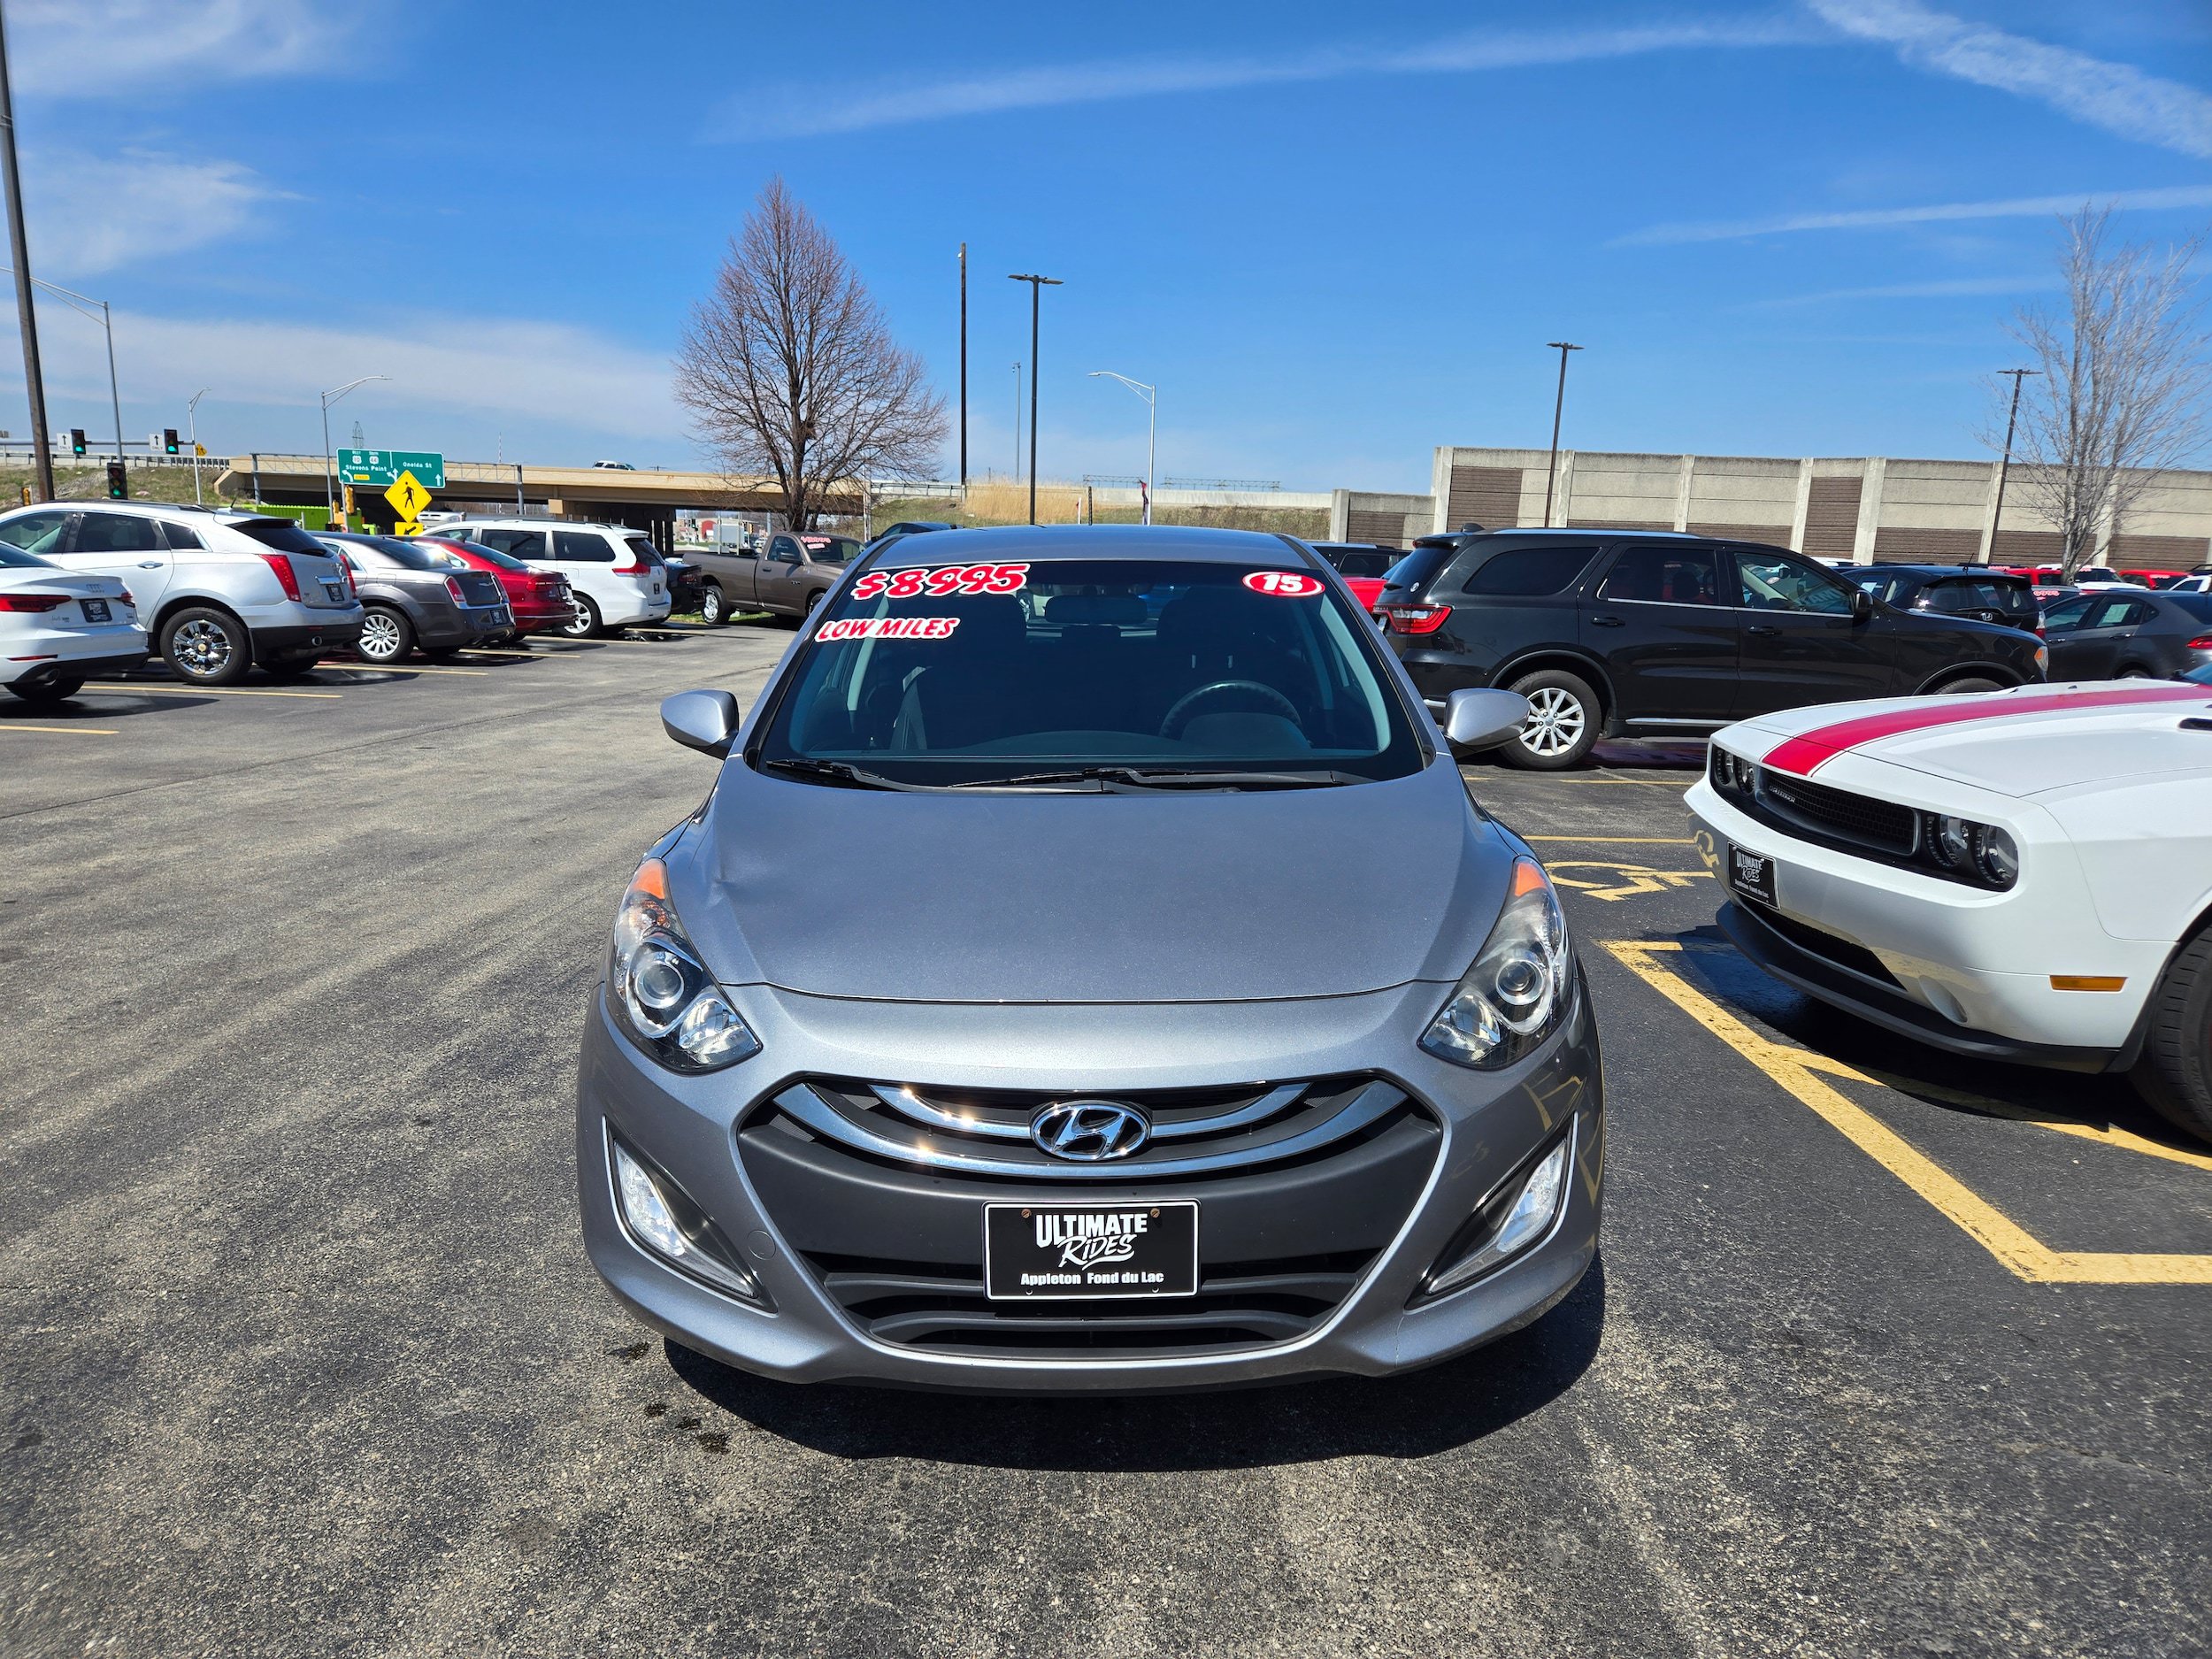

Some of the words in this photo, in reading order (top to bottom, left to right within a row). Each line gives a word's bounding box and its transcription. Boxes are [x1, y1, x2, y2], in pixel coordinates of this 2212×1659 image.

[852, 564, 1031, 599] $8995
[1263, 574, 1303, 592] 15
[818, 619, 876, 641] LOW
[875, 618, 959, 637] MILES
[1736, 851, 1763, 871] ULTIMATE
[1036, 1213, 1148, 1248] ULTIMATE
[1021, 1273, 1081, 1286] Appleton
[1087, 1272, 1119, 1284] Fond
[1121, 1272, 1139, 1283] du
[1141, 1271, 1164, 1283] Lac
